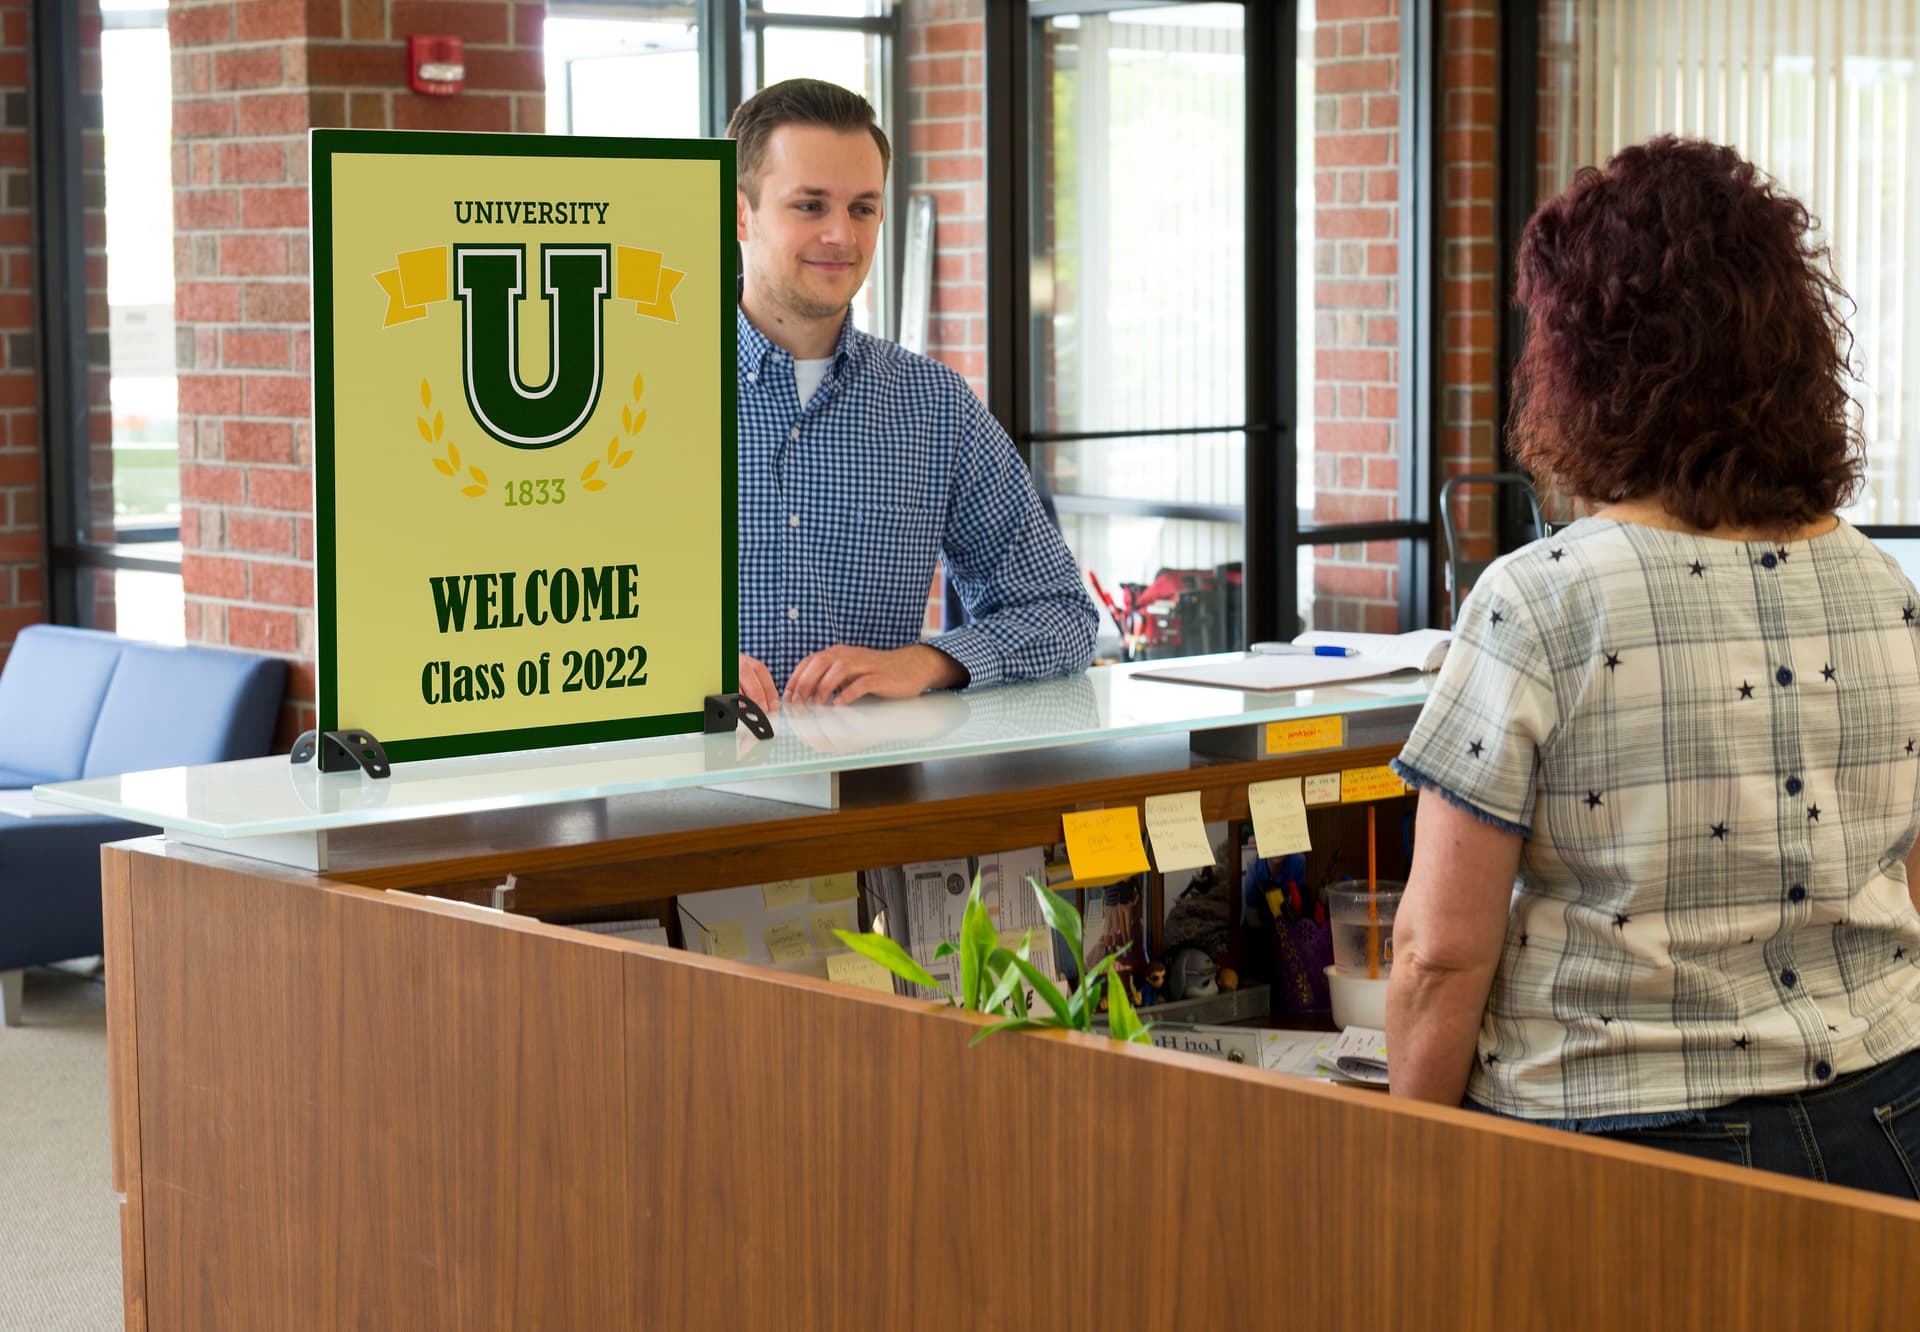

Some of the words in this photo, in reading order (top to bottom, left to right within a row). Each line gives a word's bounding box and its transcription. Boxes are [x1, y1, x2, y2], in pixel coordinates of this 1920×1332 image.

[454, 200, 610, 225] UNIVERSITY
[453, 243, 612, 450] U
[504, 478, 566, 507] 1833
[429, 564, 640, 634] WELCOME
[421, 661, 505, 705] Class
[517, 652, 551, 697] of
[562, 645, 648, 693] 2022
